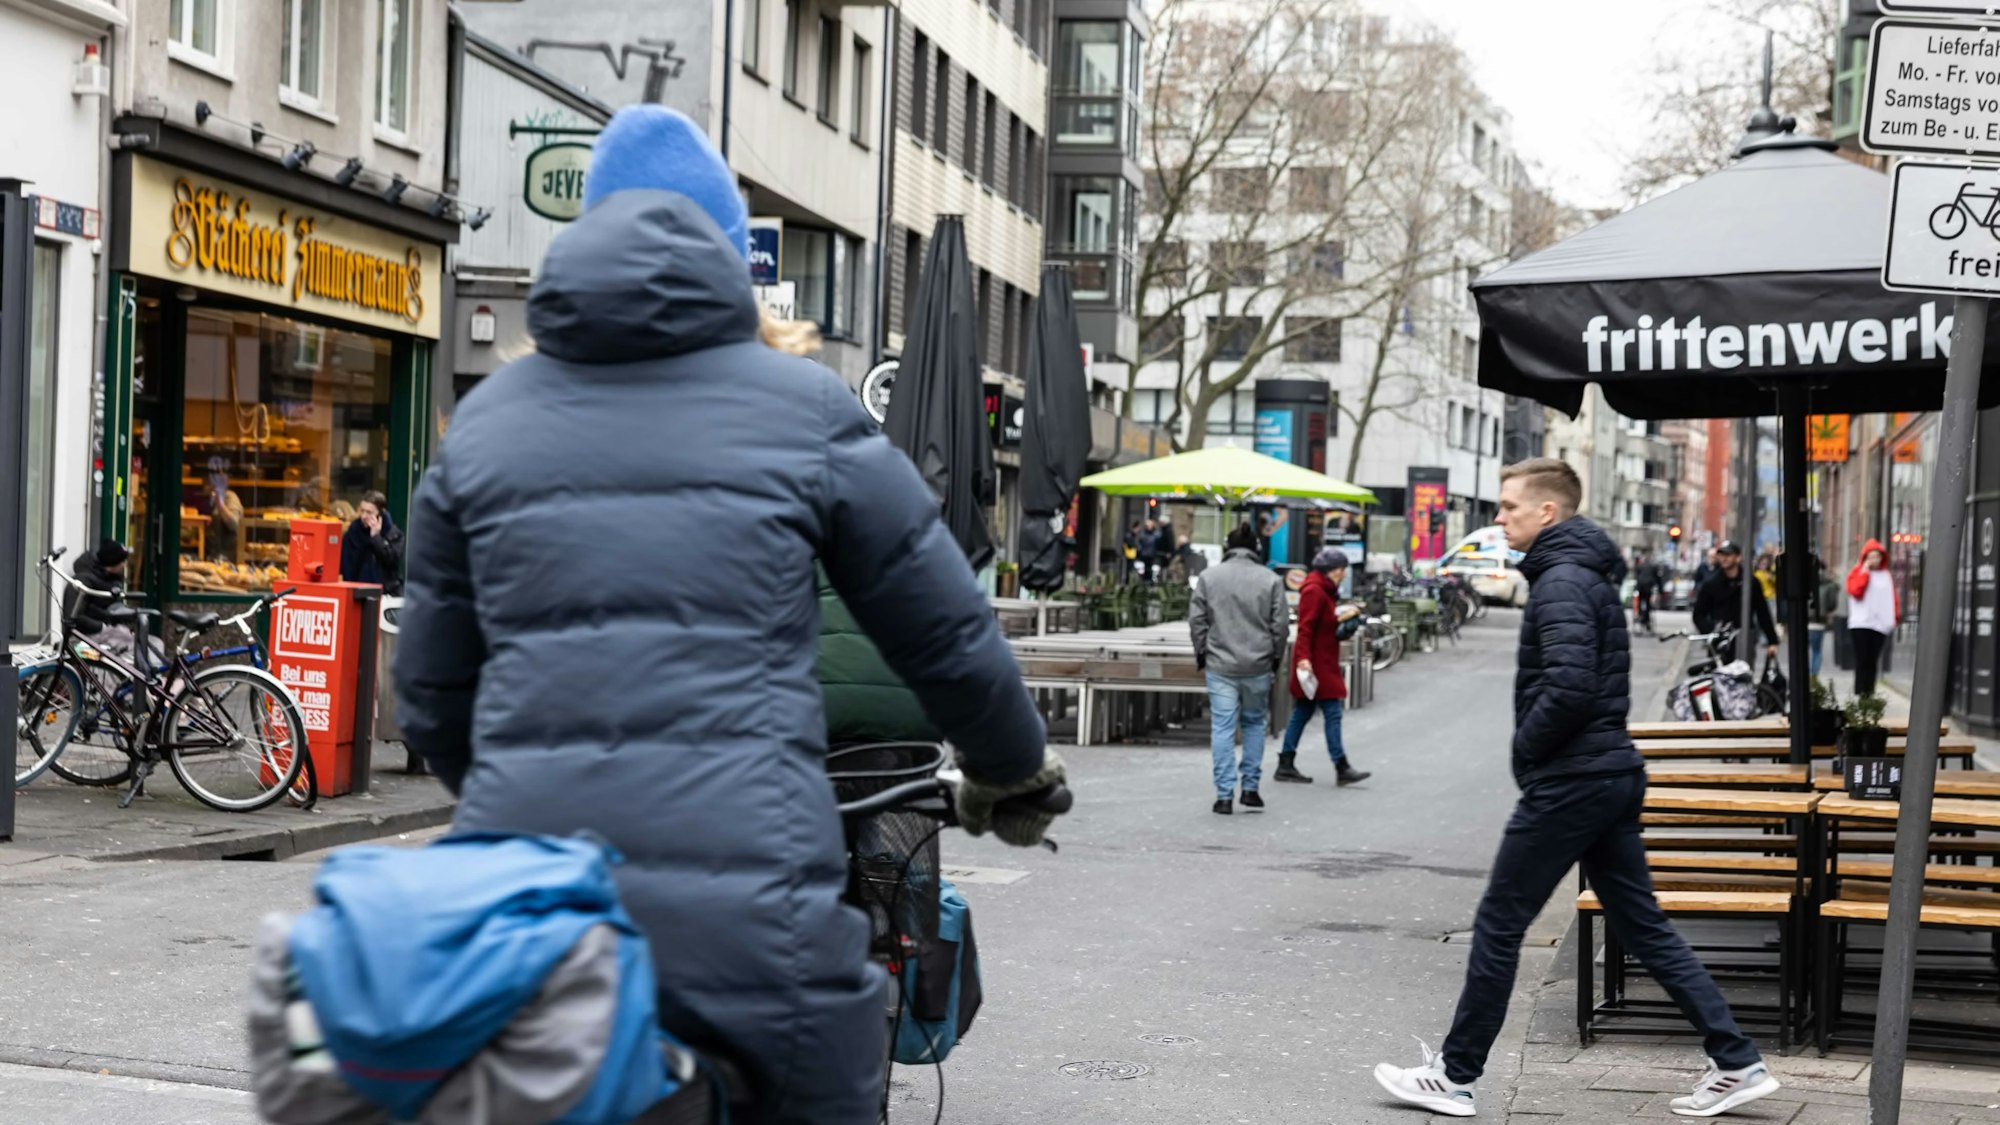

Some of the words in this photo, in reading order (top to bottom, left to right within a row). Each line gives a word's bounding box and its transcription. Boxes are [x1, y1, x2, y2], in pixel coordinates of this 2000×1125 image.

[1898, 62, 1928, 81] Mo.
[1947, 65, 1968, 83] Fr.
[1884, 88, 1972, 116] Samstags
[1880, 120, 1918, 137] zum
[1924, 119, 1947, 138] Be
[1964, 125, 1979, 140] u.
[1986, 123, 2000, 141] E
[542, 169, 585, 200] JEVE
[168, 177, 288, 288] Bäckerei
[1948, 249, 2000, 278] frei
[119, 288, 137, 319] 75
[1582, 301, 1954, 373] frittenwerk
[281, 608, 332, 646] EXPRESS
[281, 663, 301, 682] Bei
[304, 669, 327, 685] uns
[303, 690, 331, 706] man
[272, 704, 330, 727] EXESS
